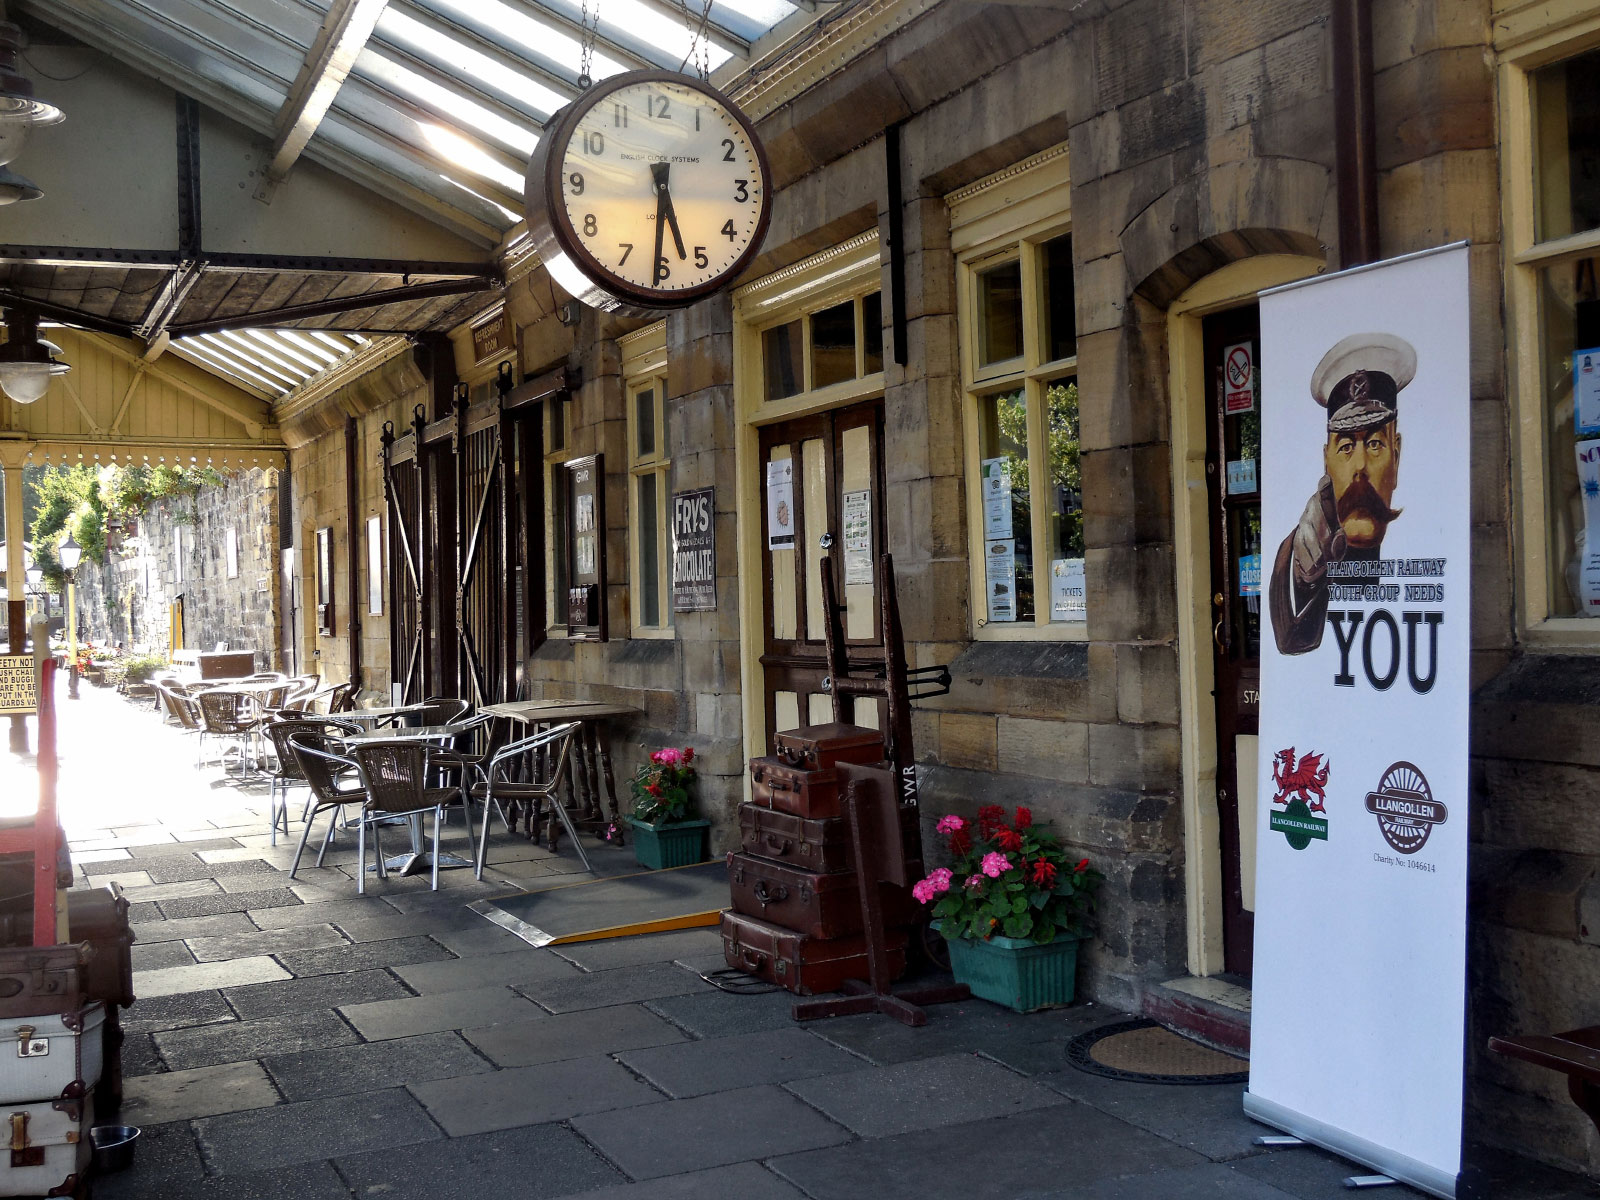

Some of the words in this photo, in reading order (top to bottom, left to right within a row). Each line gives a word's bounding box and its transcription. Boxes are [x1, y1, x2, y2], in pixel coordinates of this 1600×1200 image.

[614, 104, 628, 128] 11
[647, 94, 672, 120] 12
[695, 108, 701, 132] 1
[583, 131, 605, 156] 10
[720, 138, 736, 162] 2
[620, 153, 645, 161] ENGLISH
[671, 156, 700, 164] SYSTEMS
[569, 172, 585, 196] 9
[733, 179, 749, 203] 3
[583, 213, 598, 237] 8
[720, 218, 738, 243] 4
[618, 243, 634, 267] 7
[694, 246, 709, 270] 5
[656, 256, 671, 281] 6
[575, 469, 589, 484] GWR
[675, 495, 709, 535] FRY'S
[674, 550, 713, 582] CHOCOLATE
[1326, 560, 1395, 578] LLANGOLLEN
[1397, 558, 1447, 577] RAILWAY
[1328, 583, 1363, 602] YOUTH
[1364, 583, 1400, 602] GROUP
[1404, 583, 1445, 602] NEEDS
[1326, 608, 1444, 695] YOU
[14, 691, 22, 699] IN
[902, 765, 917, 807] GWR
[1375, 798, 1434, 818] LLANGOLLEN
[1272, 815, 1303, 829] LLANGOLLEN
[1303, 822, 1326, 833] RAILWAY
[1373, 852, 1395, 867] Charity
[1395, 857, 1406, 867] No:
[1407, 859, 1436, 873] 1046614
